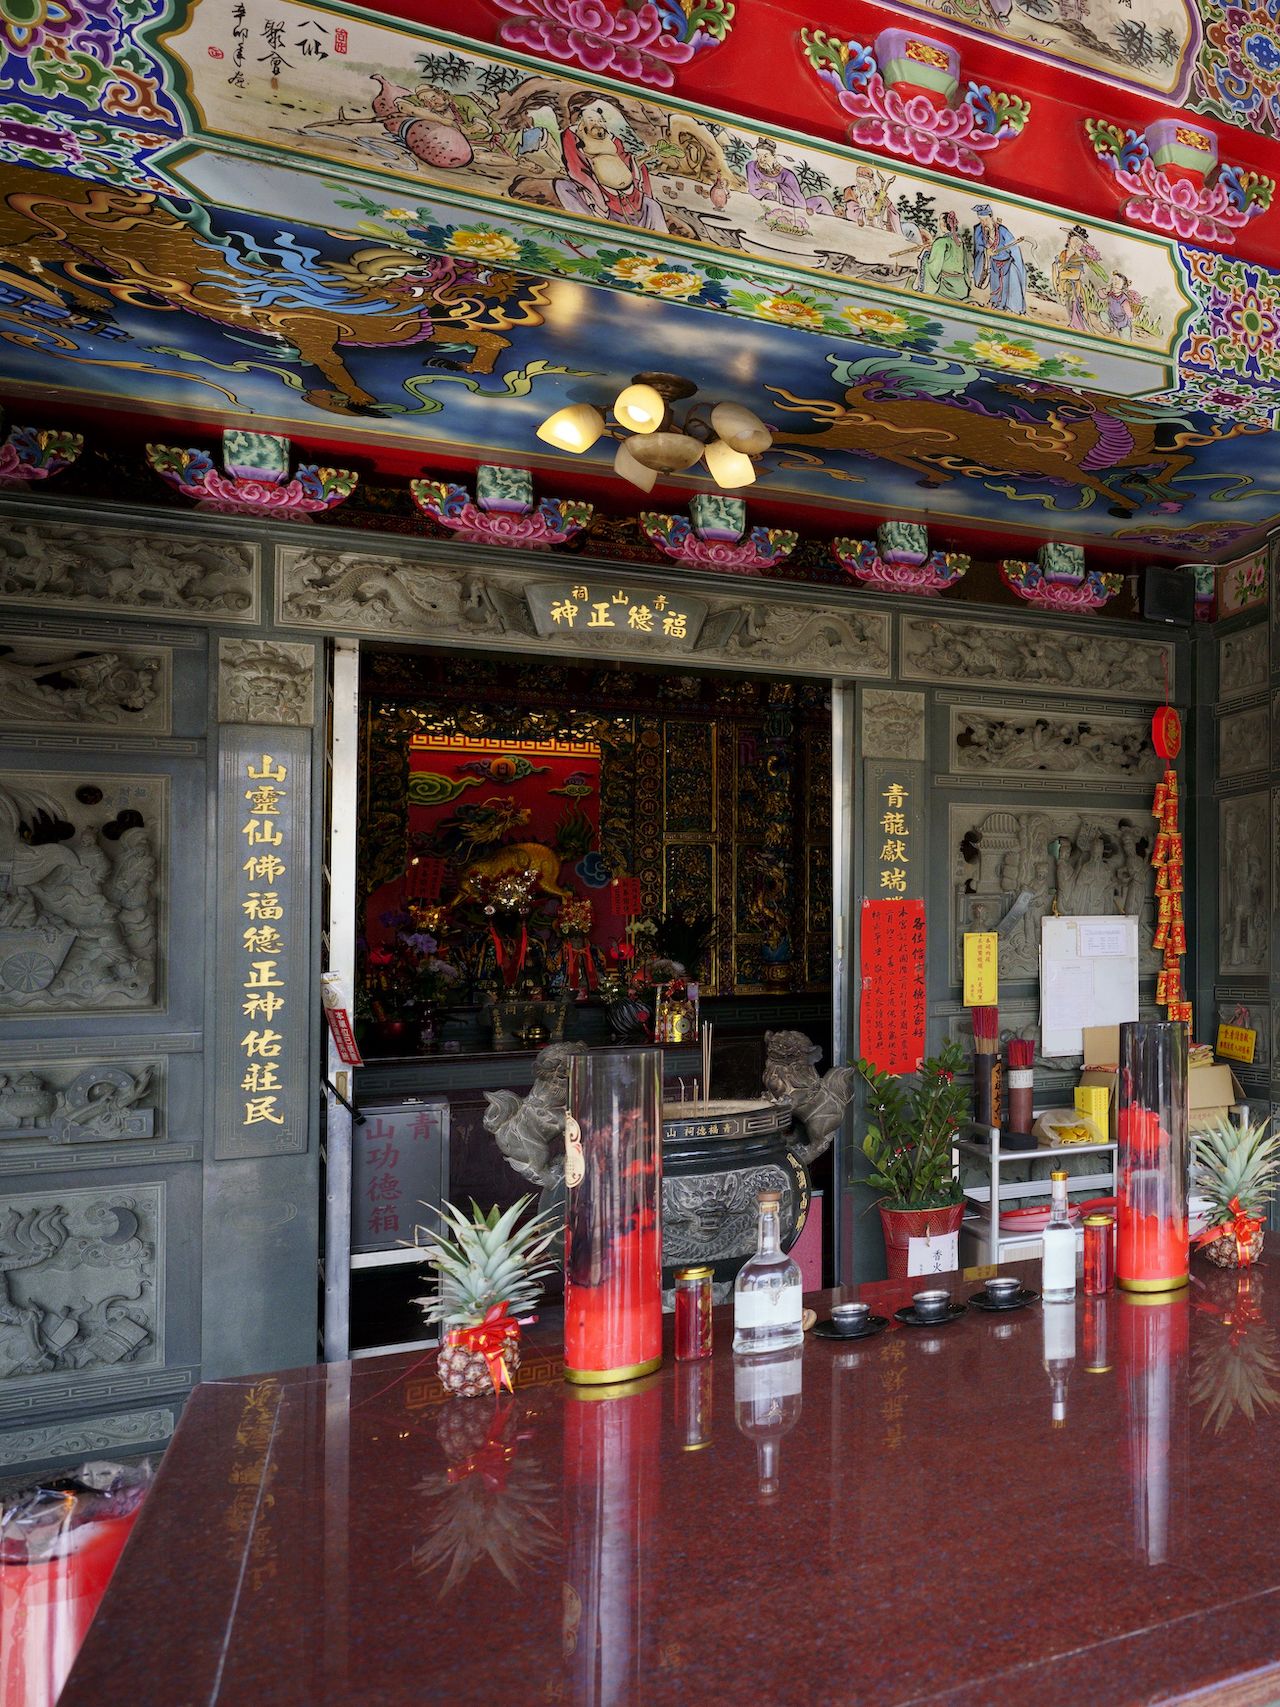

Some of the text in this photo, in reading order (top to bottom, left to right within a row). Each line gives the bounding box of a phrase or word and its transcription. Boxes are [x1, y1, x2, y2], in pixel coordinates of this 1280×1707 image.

[257, 19, 296, 75] 聚會
[550, 599, 688, 639] 福德正神
[571, 585, 669, 612] 青山祠
[879, 783, 909, 900] 青龍獻瑞
[406, 1112, 439, 1140] 青
[366, 1119, 401, 1234] 山功德箱
